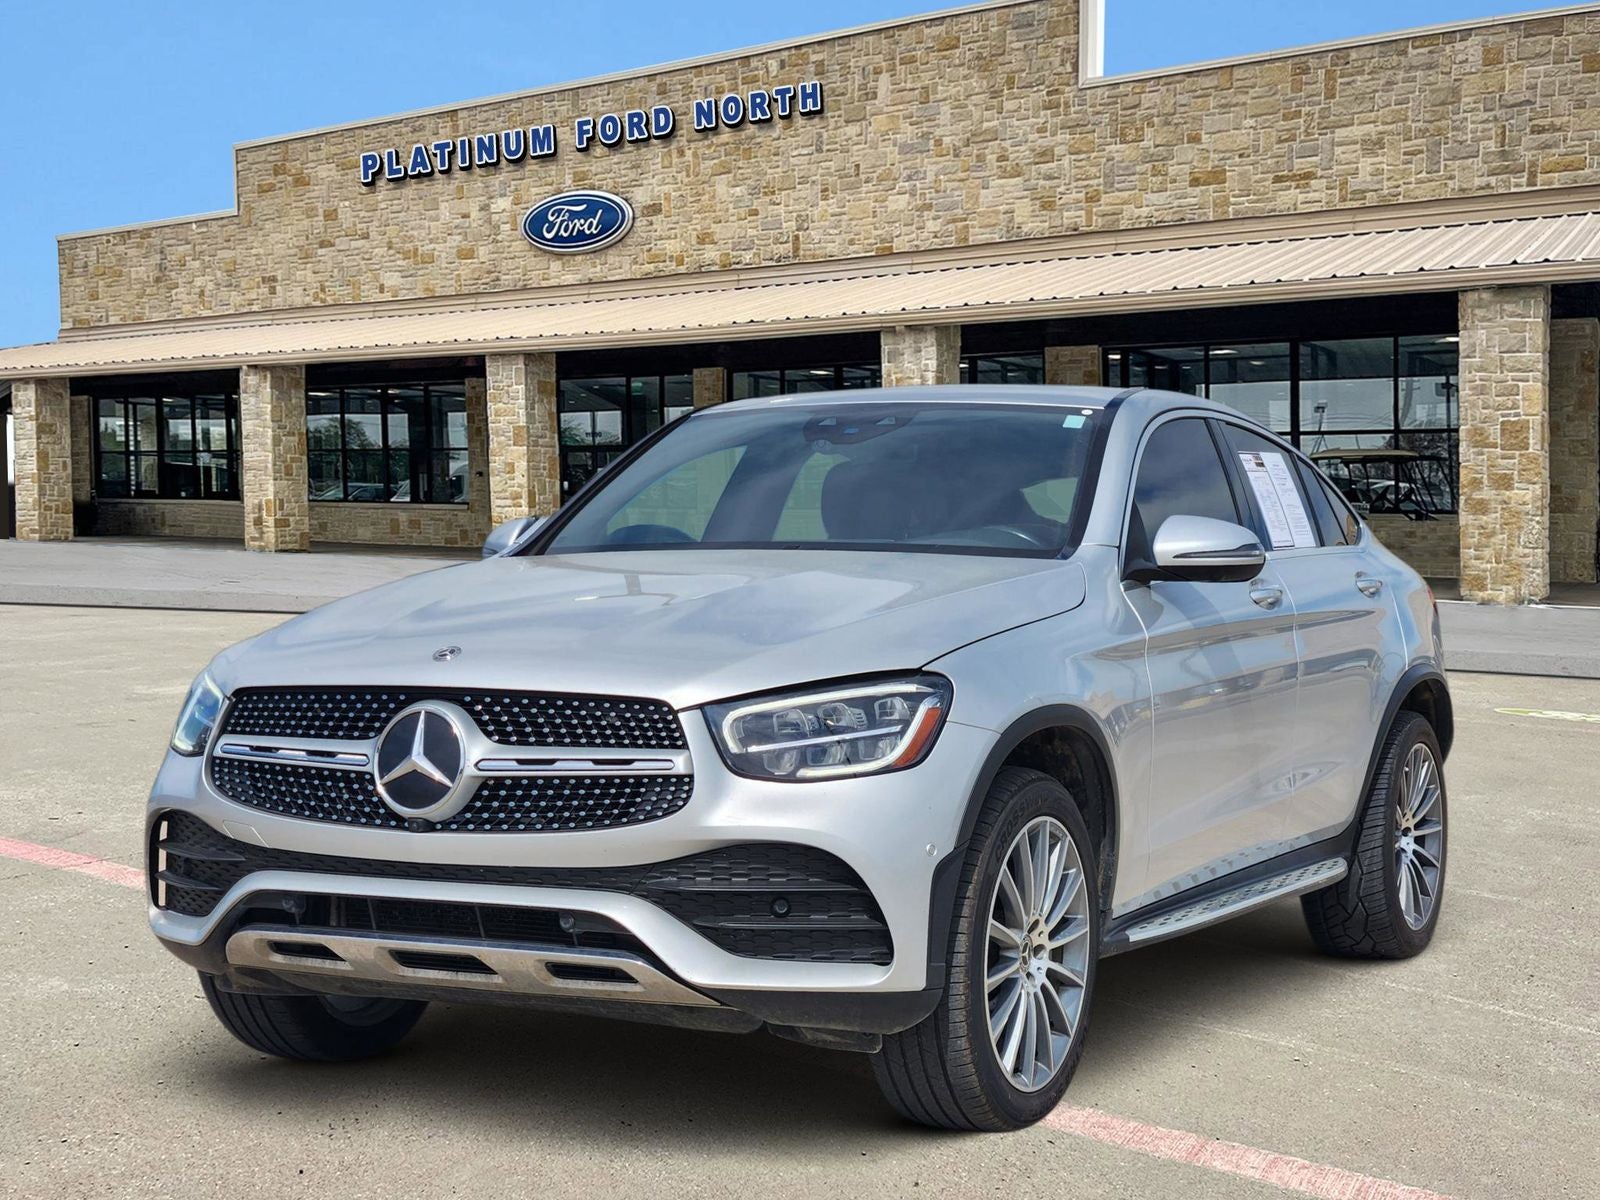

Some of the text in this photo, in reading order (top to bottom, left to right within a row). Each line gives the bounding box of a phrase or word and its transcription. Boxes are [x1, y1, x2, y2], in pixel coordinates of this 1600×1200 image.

[360, 81, 822, 185] PLATINUM FORD NORTH
[543, 203, 603, 240] Ford
